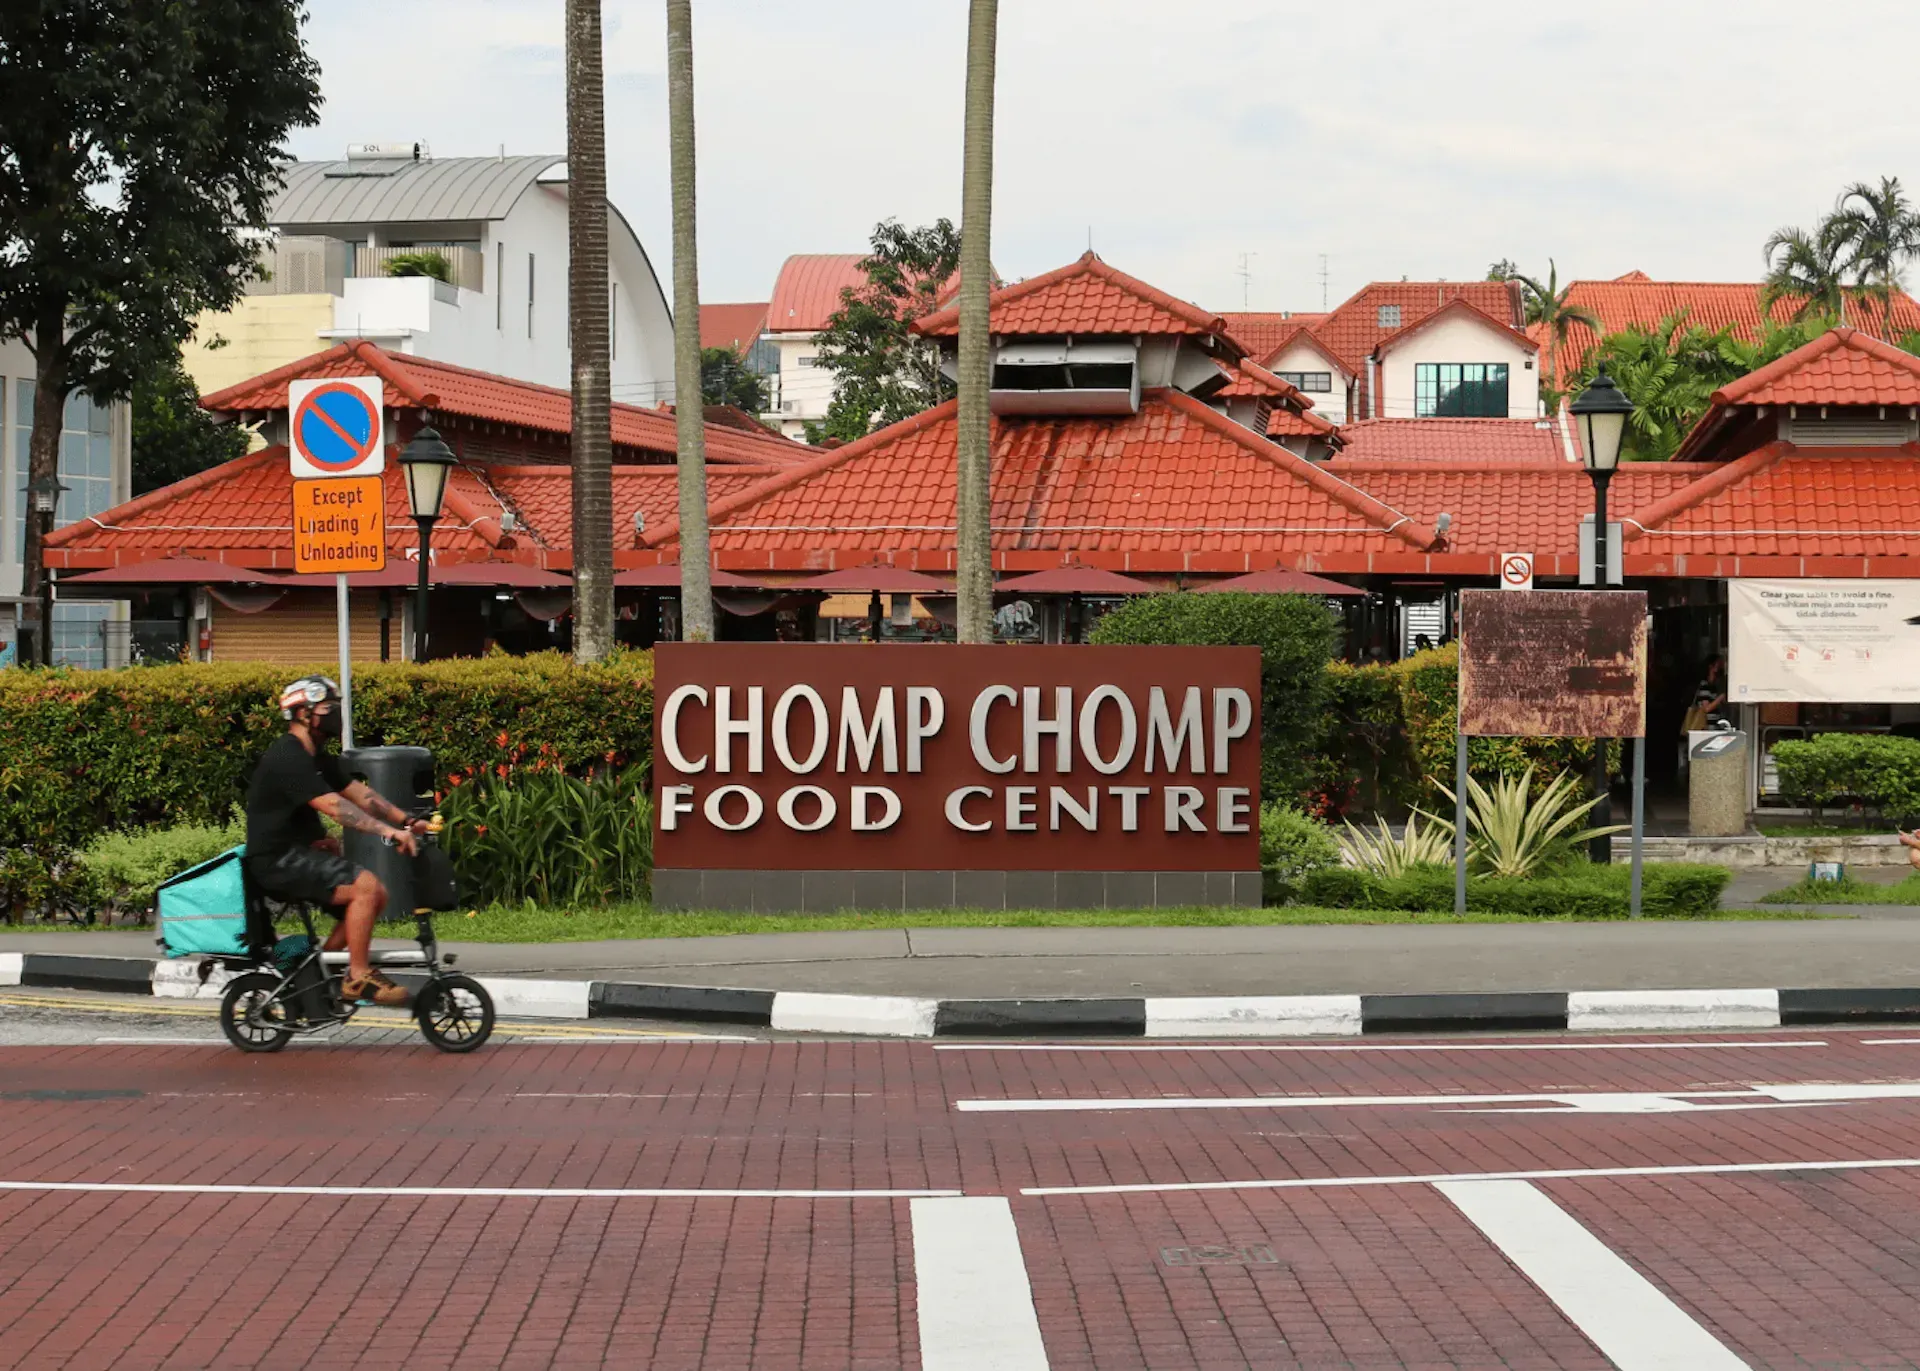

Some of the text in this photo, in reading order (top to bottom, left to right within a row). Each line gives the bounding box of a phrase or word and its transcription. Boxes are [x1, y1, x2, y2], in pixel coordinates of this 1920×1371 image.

[313, 487, 362, 508] Except
[299, 514, 359, 536] Loading
[301, 542, 378, 563] Unloading
[1785, 592, 1804, 600] your
[660, 683, 1253, 776] CHOMP CHOMP
[659, 783, 1251, 833] FOOD CENTRE
